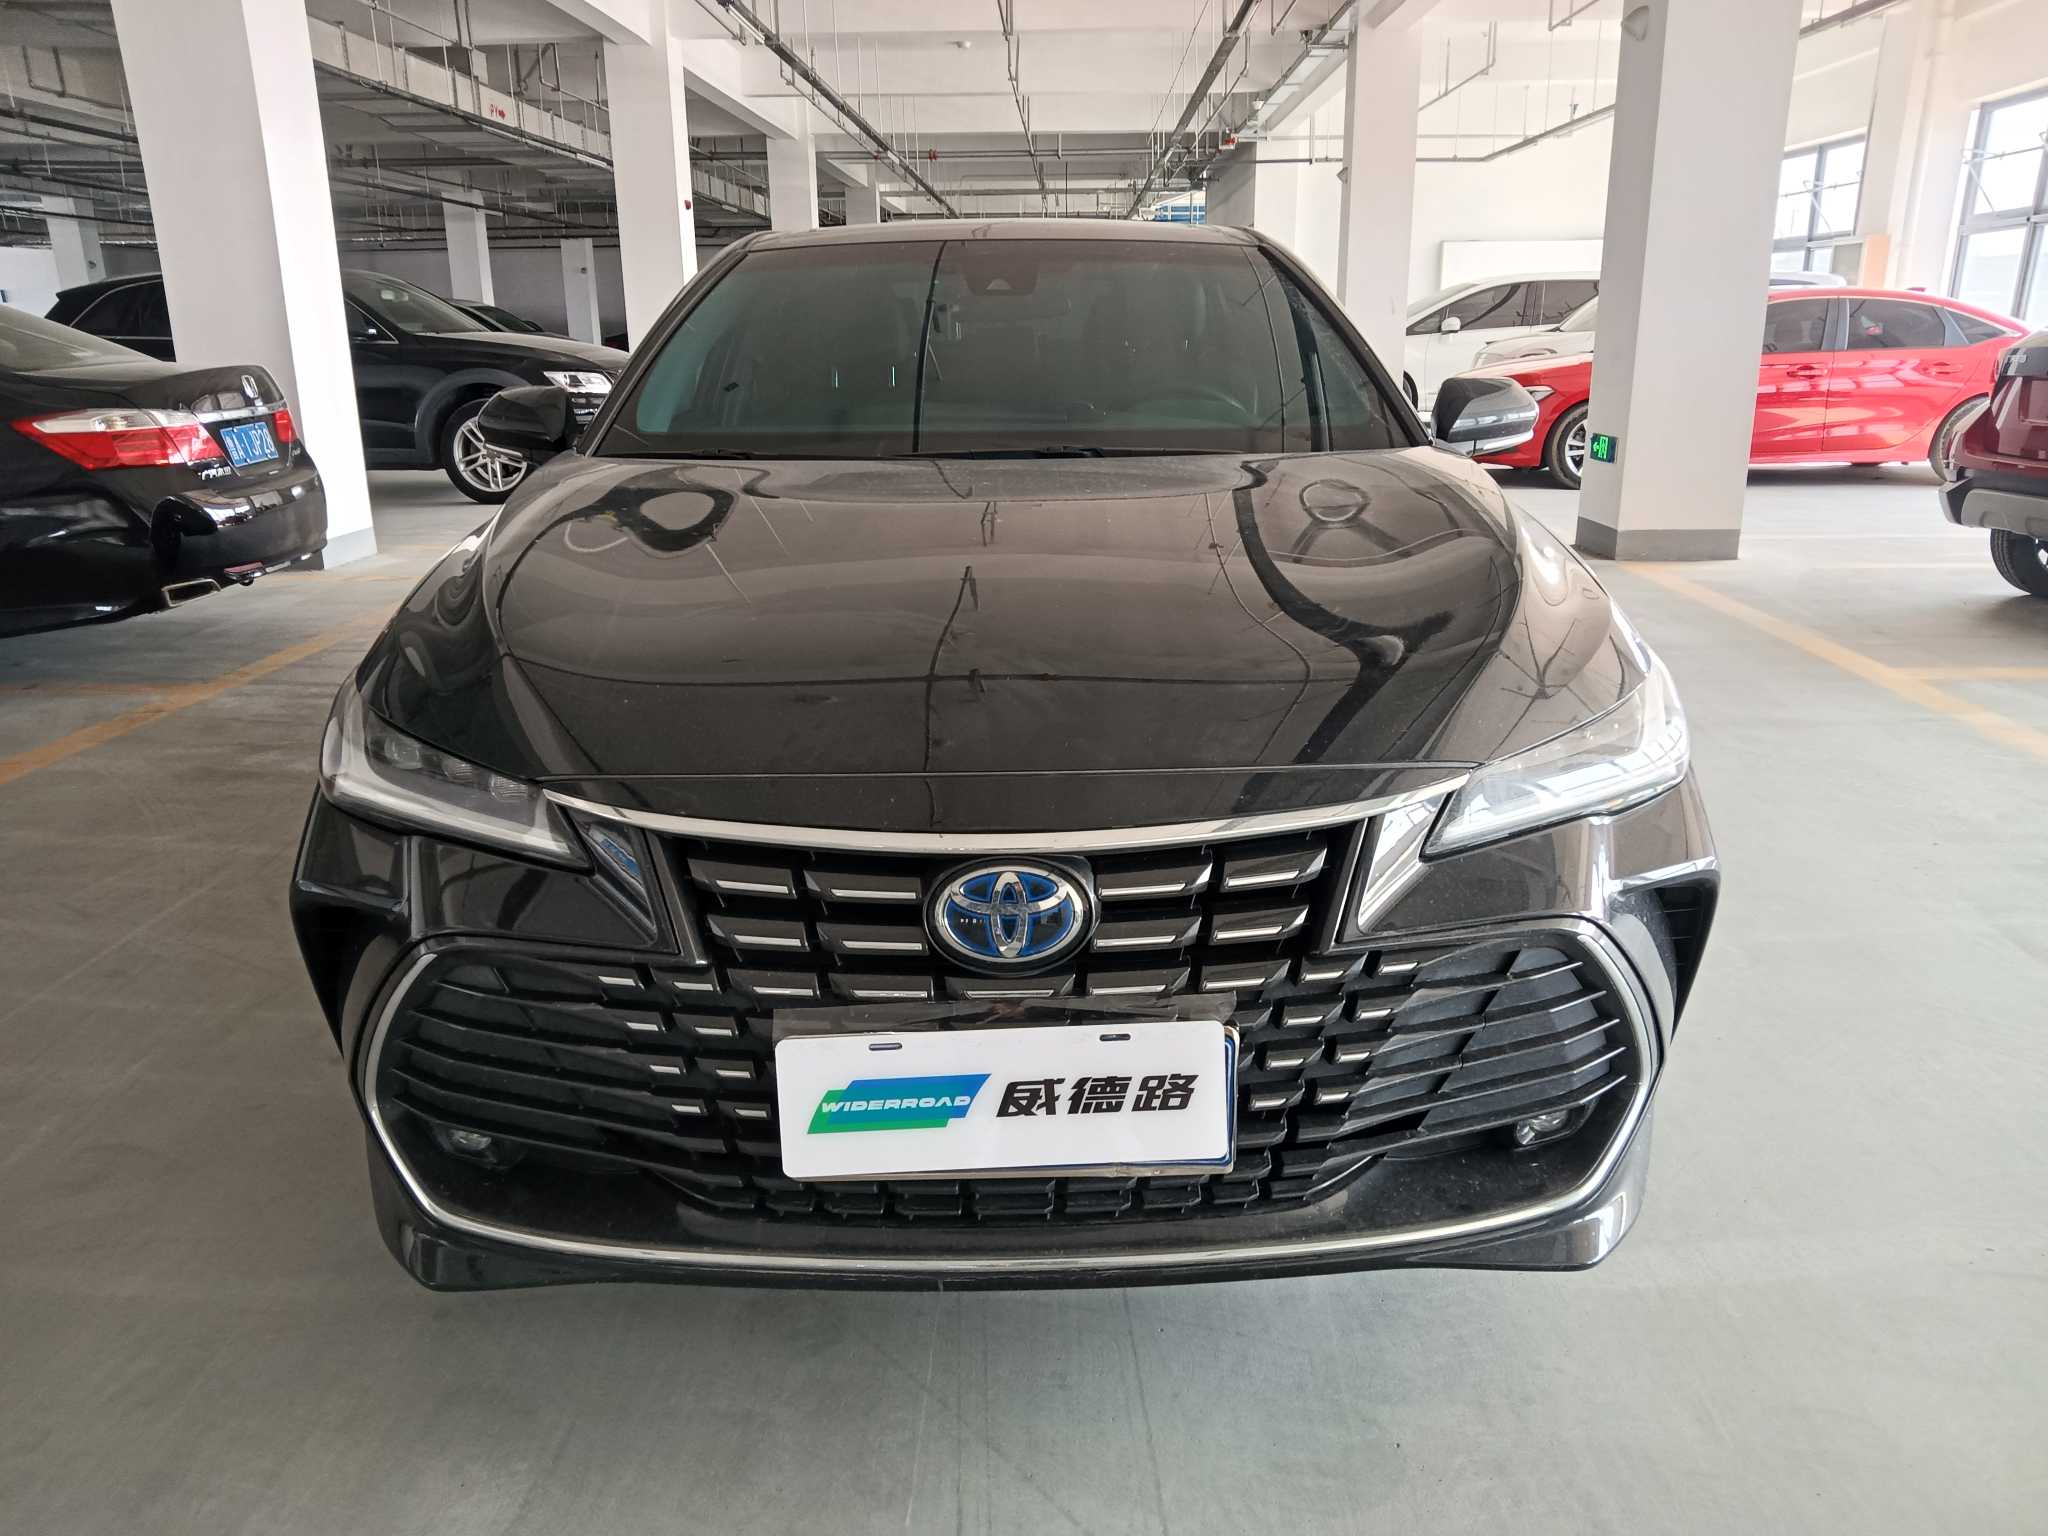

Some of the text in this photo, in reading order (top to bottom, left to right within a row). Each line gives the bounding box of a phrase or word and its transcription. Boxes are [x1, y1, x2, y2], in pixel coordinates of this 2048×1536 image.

[822, 1073, 1199, 1118] WIDERROAD 威德路
